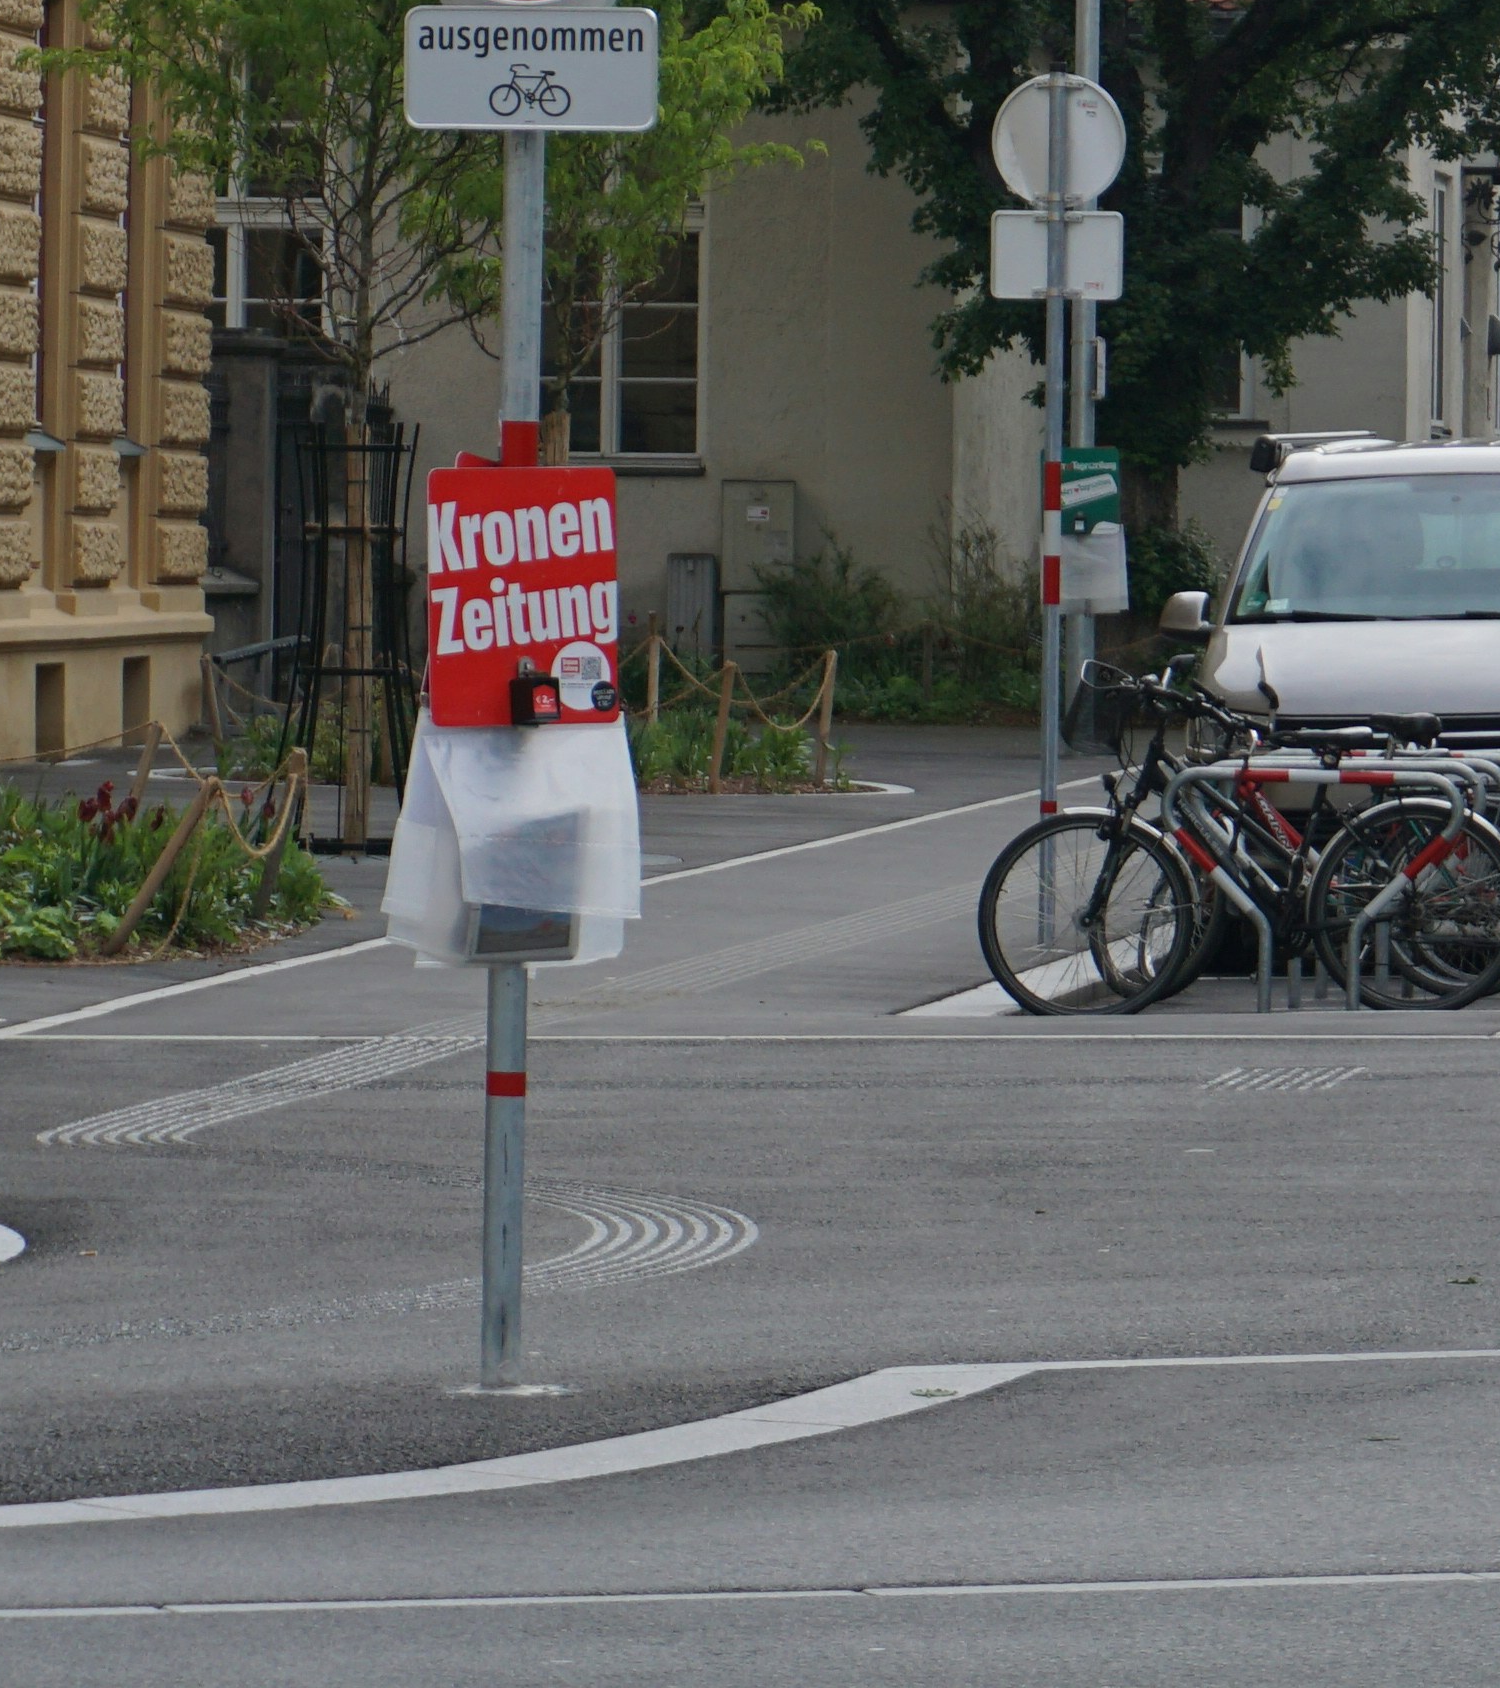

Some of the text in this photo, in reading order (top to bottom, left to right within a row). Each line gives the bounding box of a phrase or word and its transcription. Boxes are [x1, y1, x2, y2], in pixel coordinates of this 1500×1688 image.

[418, 25, 644, 58] ausgenommen
[428, 496, 614, 575] Kronen
[431, 577, 618, 656] Zeitung
